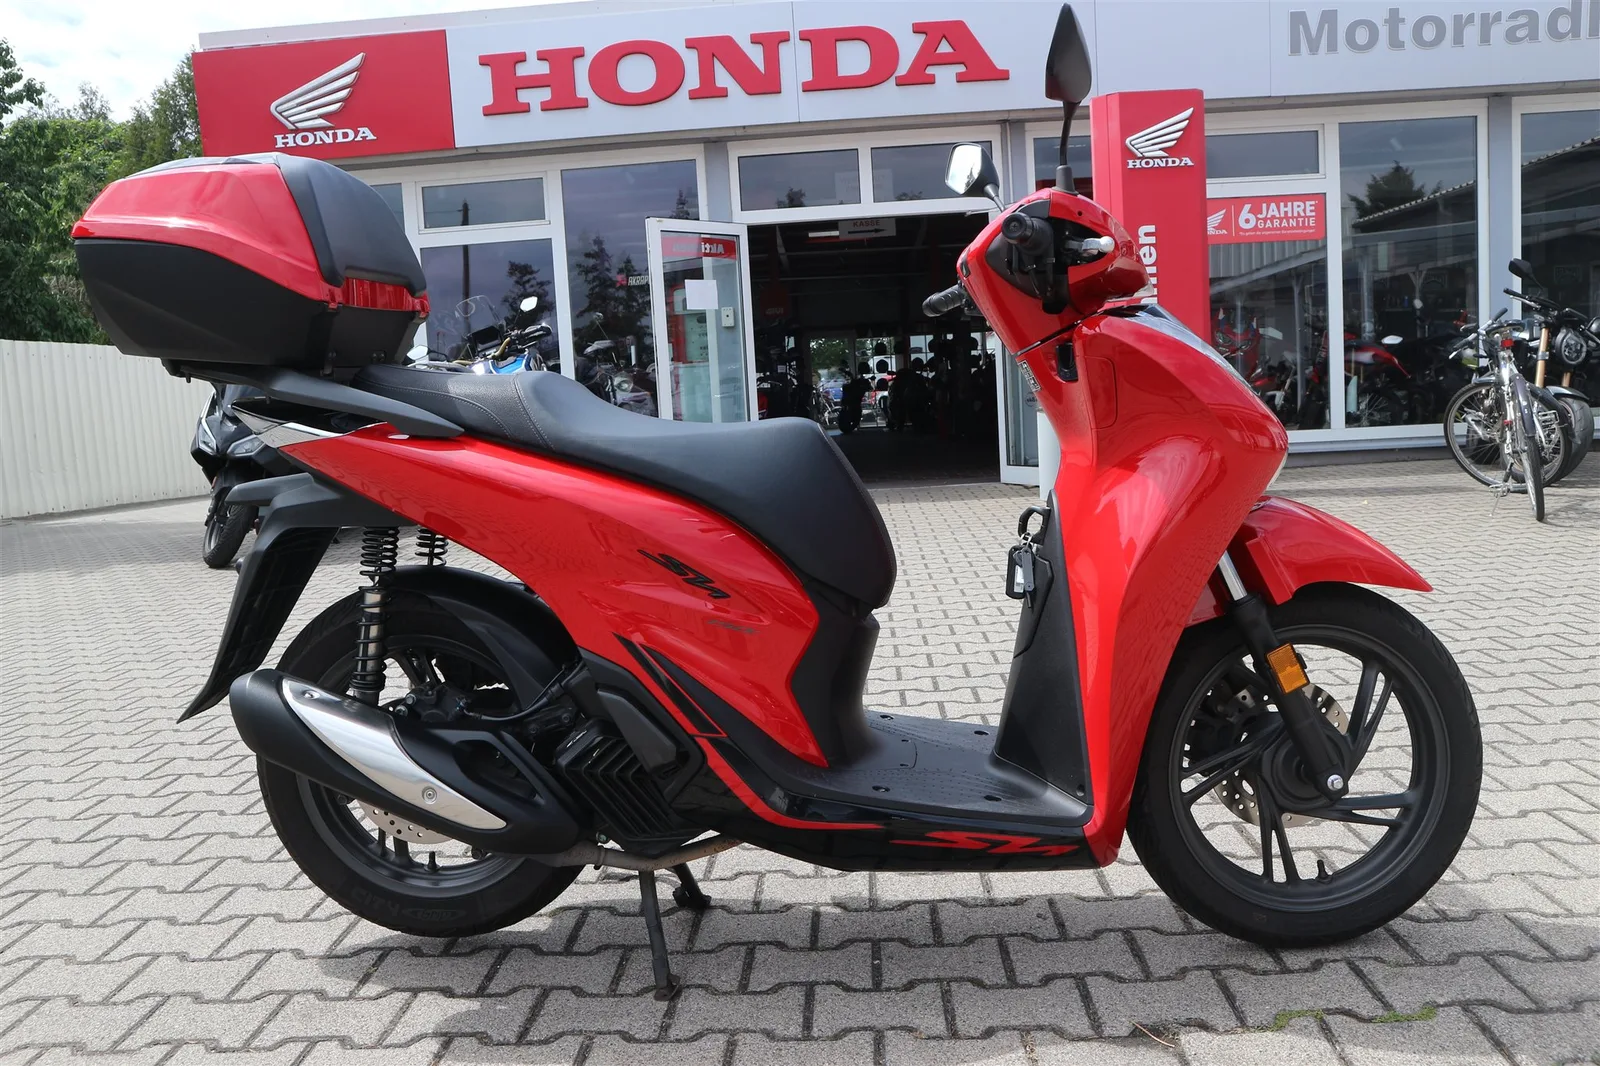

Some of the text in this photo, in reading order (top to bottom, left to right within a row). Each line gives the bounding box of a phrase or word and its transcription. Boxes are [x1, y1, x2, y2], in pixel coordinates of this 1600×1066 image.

[478, 20, 1010, 116] HONDA
[274, 126, 377, 148] HONDA
[1127, 157, 1194, 169] HONDA
[1238, 203, 1257, 230] 6
[852, 219, 881, 228] KASSE
[1257, 217, 1316, 229] GARANTIE
[628, 275, 650, 286] AKRAP
